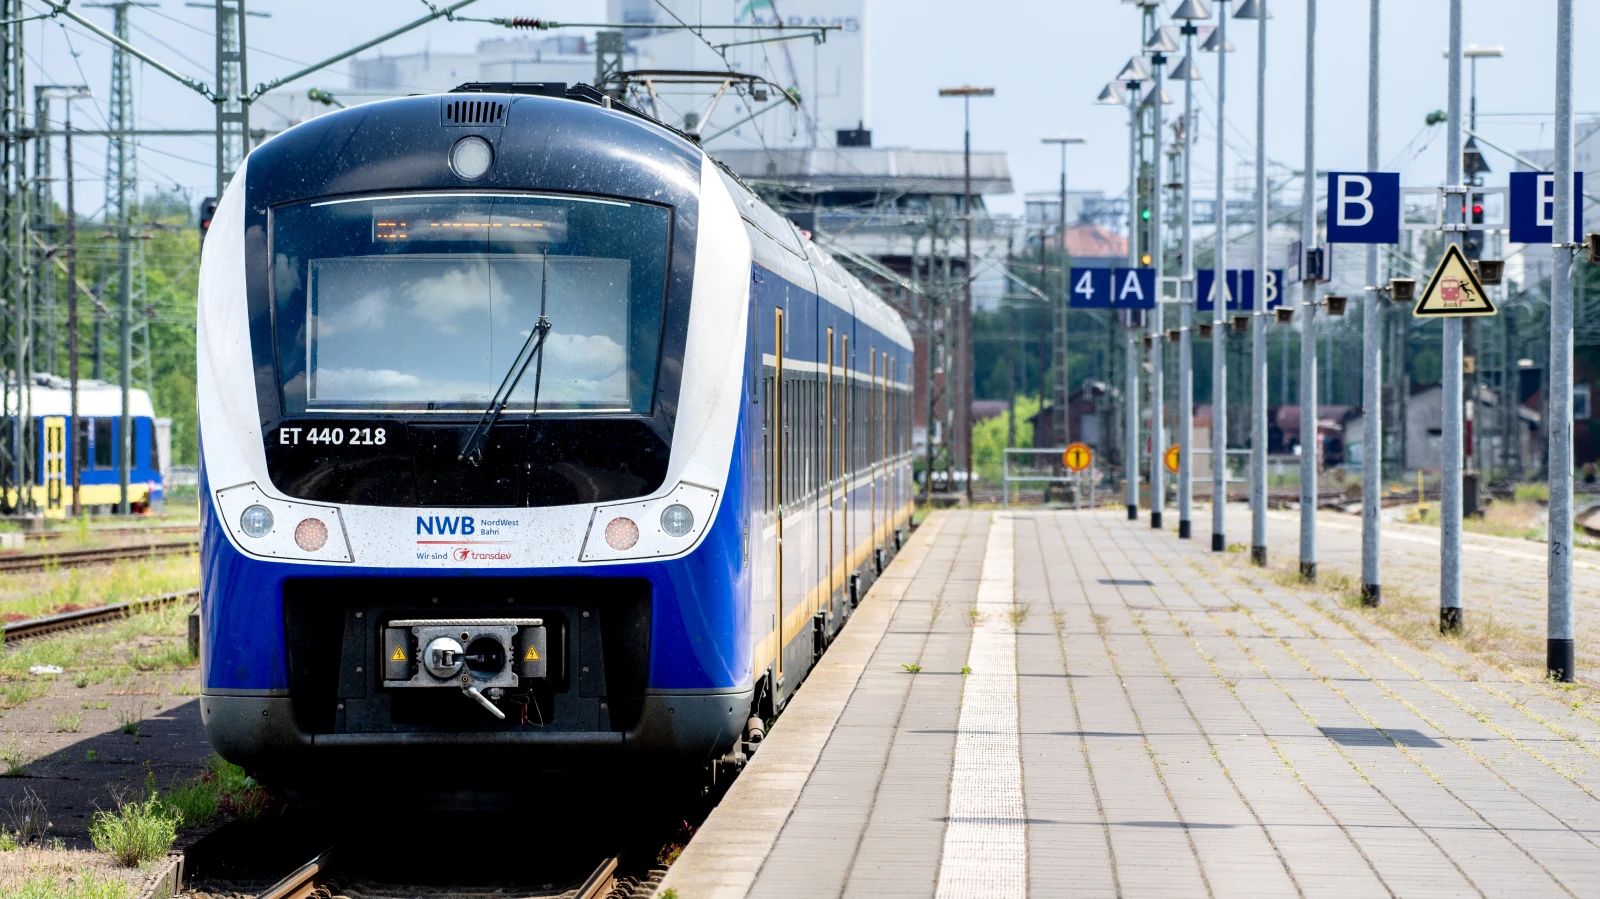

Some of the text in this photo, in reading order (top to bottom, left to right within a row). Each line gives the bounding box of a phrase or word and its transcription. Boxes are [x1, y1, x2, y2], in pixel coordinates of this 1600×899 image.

[1336, 174, 1375, 227] B
[1074, 270, 1144, 300] 4 A
[279, 427, 387, 445] ET 440 218
[416, 516, 475, 535] NWB
[480, 528, 500, 536] Bahn
[416, 552, 512, 560] Wir sind transdev
